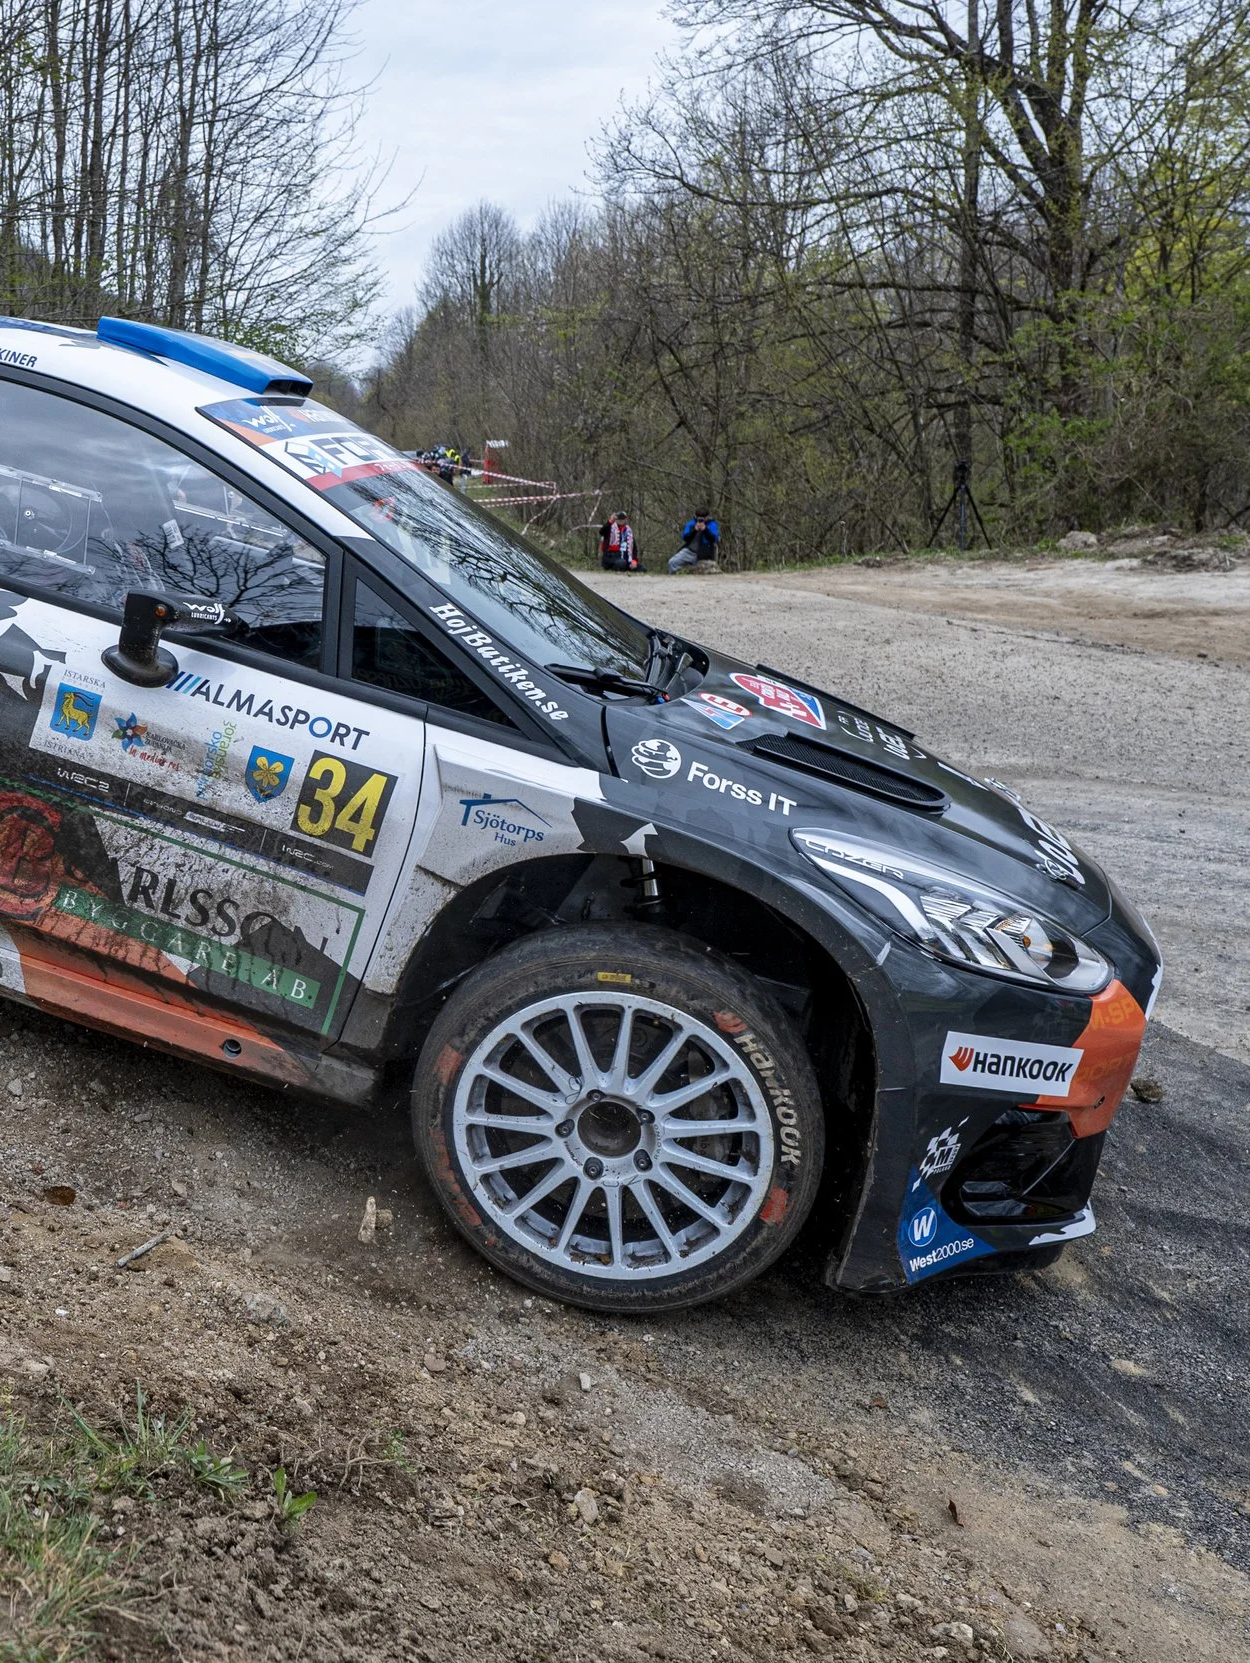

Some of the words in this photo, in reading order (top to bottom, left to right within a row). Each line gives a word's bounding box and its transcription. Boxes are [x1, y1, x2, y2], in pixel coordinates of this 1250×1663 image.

[191, 612, 217, 621] LUBRICANTS
[63, 668, 106, 689] ISTARSKA
[429, 602, 569, 720] HojButiken.se
[191, 679, 370, 750] ALMASPORT
[297, 757, 395, 853] 34
[687, 761, 763, 806] Forss
[768, 792, 797, 816] IT
[474, 809, 545, 843] Sjötorps
[494, 832, 517, 847] Hus
[63, 890, 238, 972] BYGGARE
[261, 969, 307, 1000] AB
[913, 1210, 936, 1242] W
[909, 1237, 975, 1273] West2000.se
